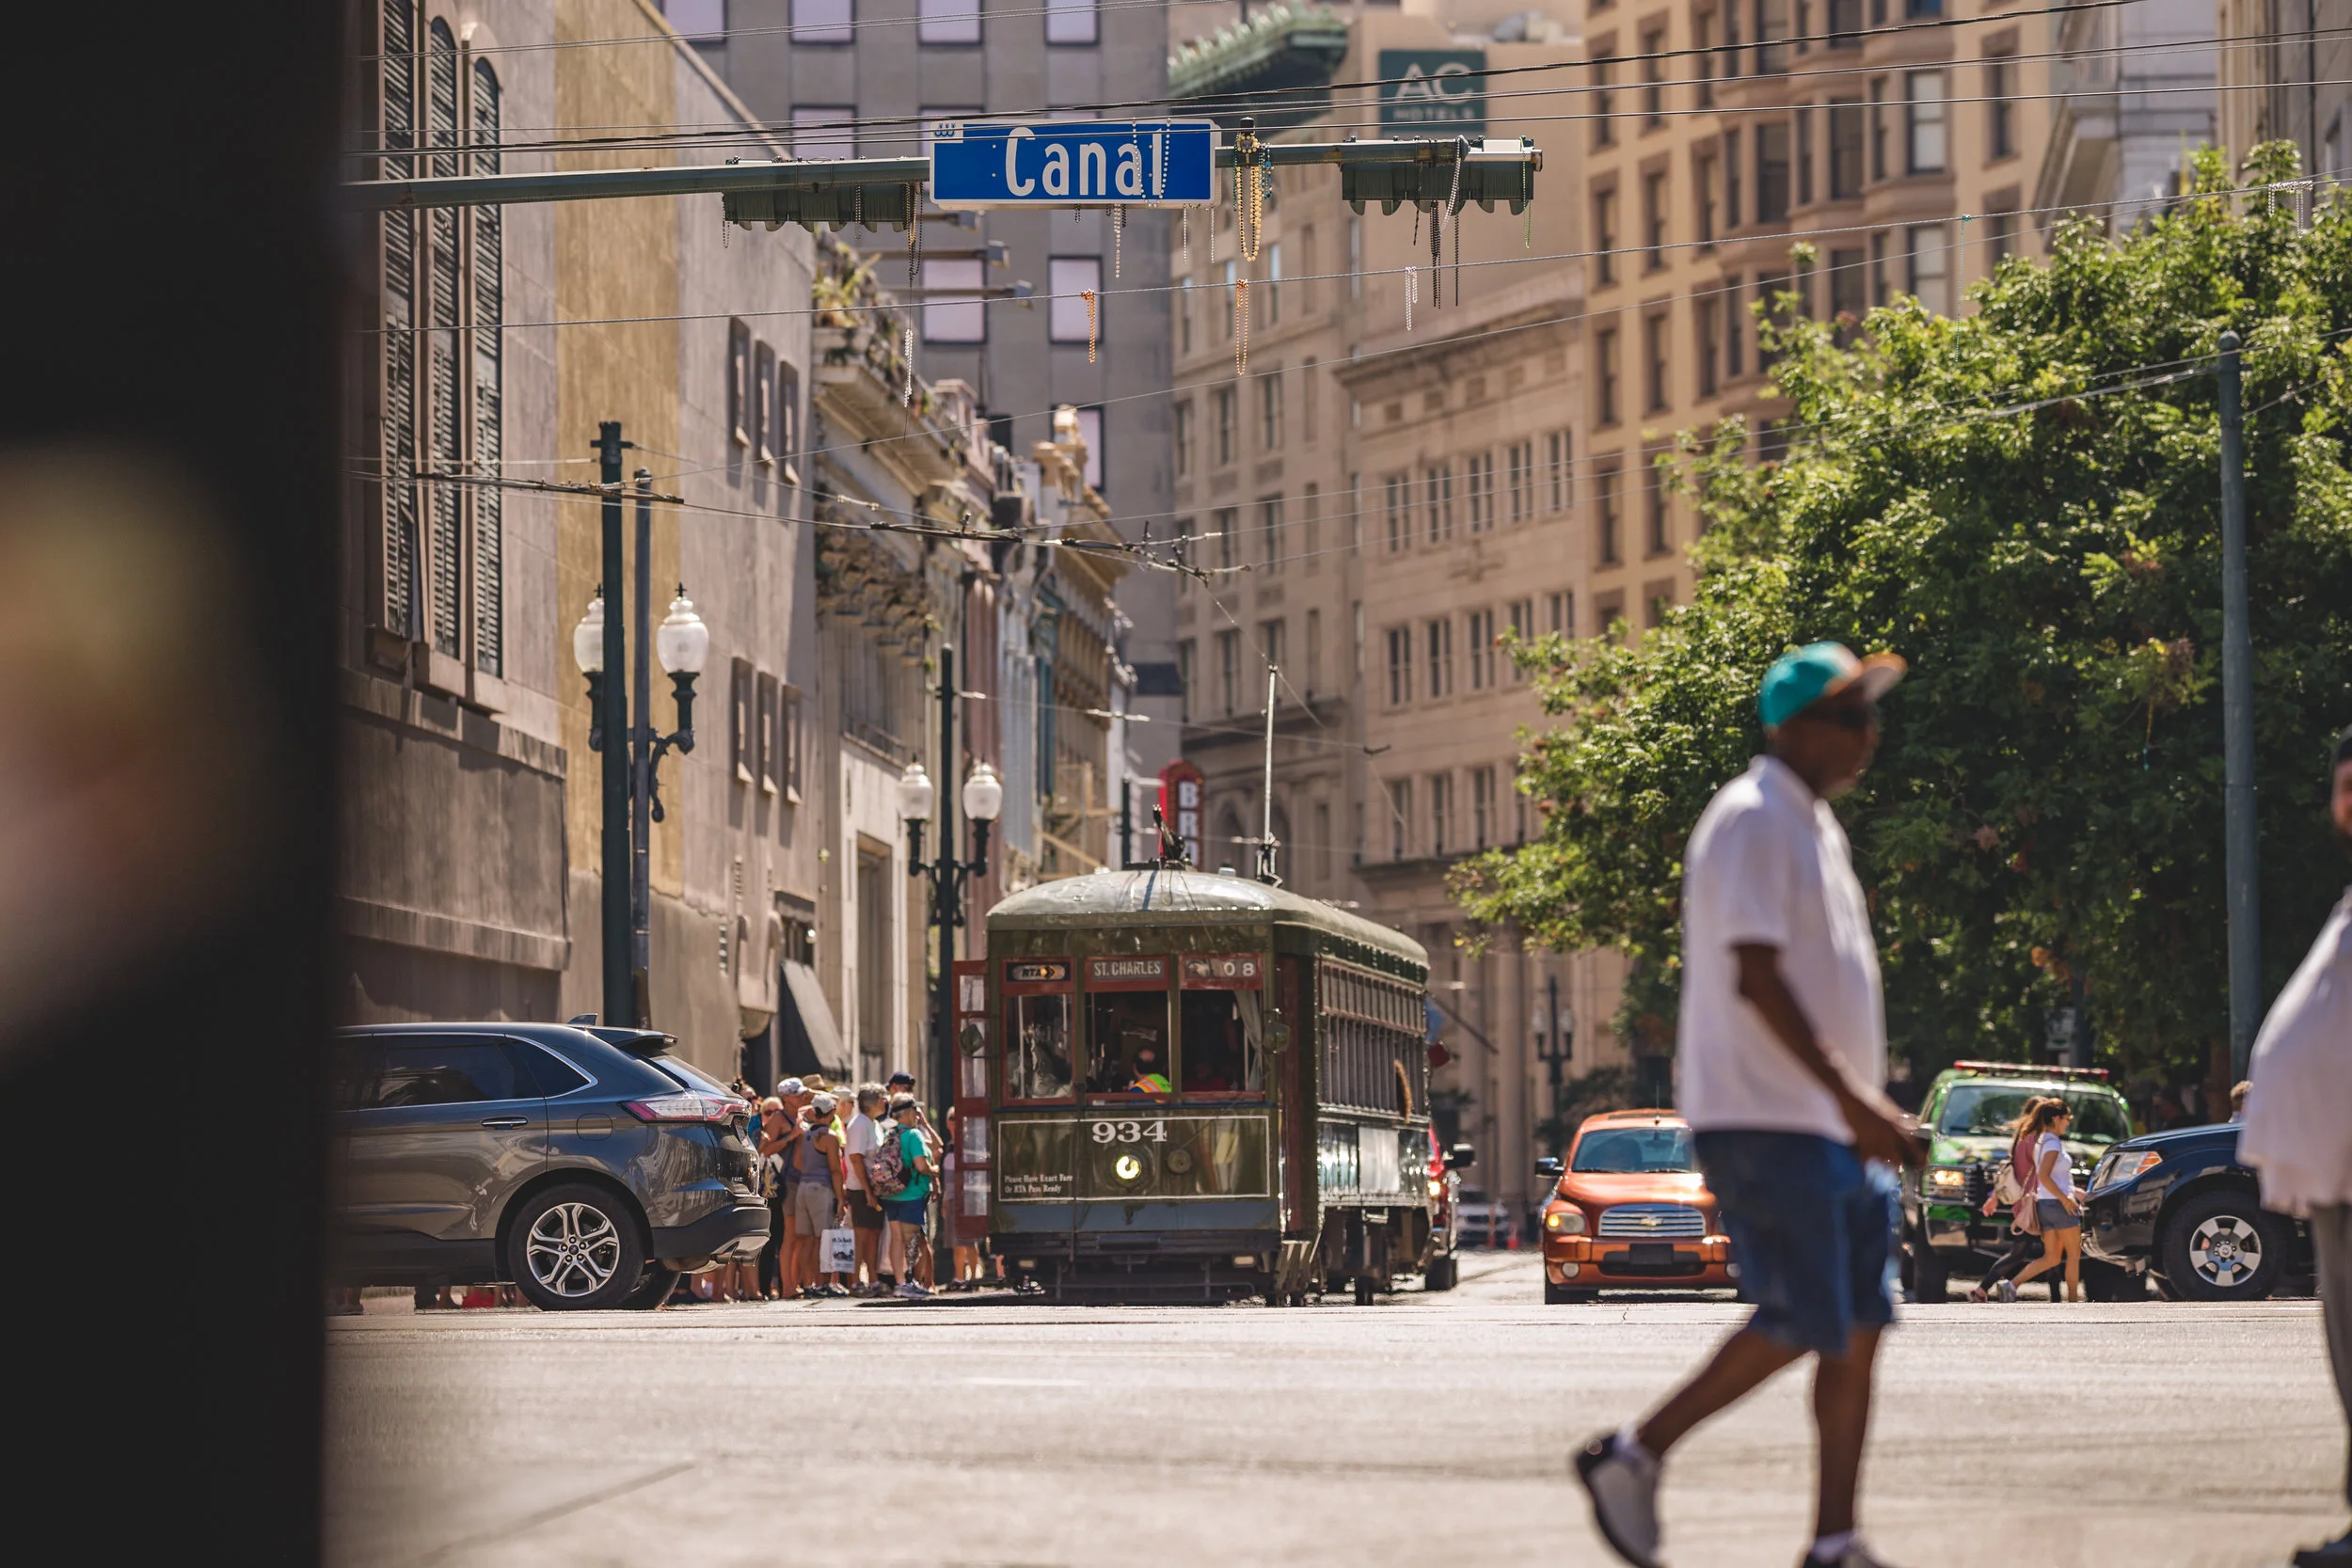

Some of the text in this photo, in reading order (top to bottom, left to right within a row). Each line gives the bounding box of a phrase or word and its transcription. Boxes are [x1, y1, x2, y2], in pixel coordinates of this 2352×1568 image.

[1394, 62, 1474, 105] AC
[1005, 126, 1163, 197] Canal
[1093, 959, 1162, 976] ST. CHARLES
[1091, 1120, 1168, 1144] 934
[1040, 1174, 1058, 1182] Exact
[1059, 1173, 1073, 1182] Fare
